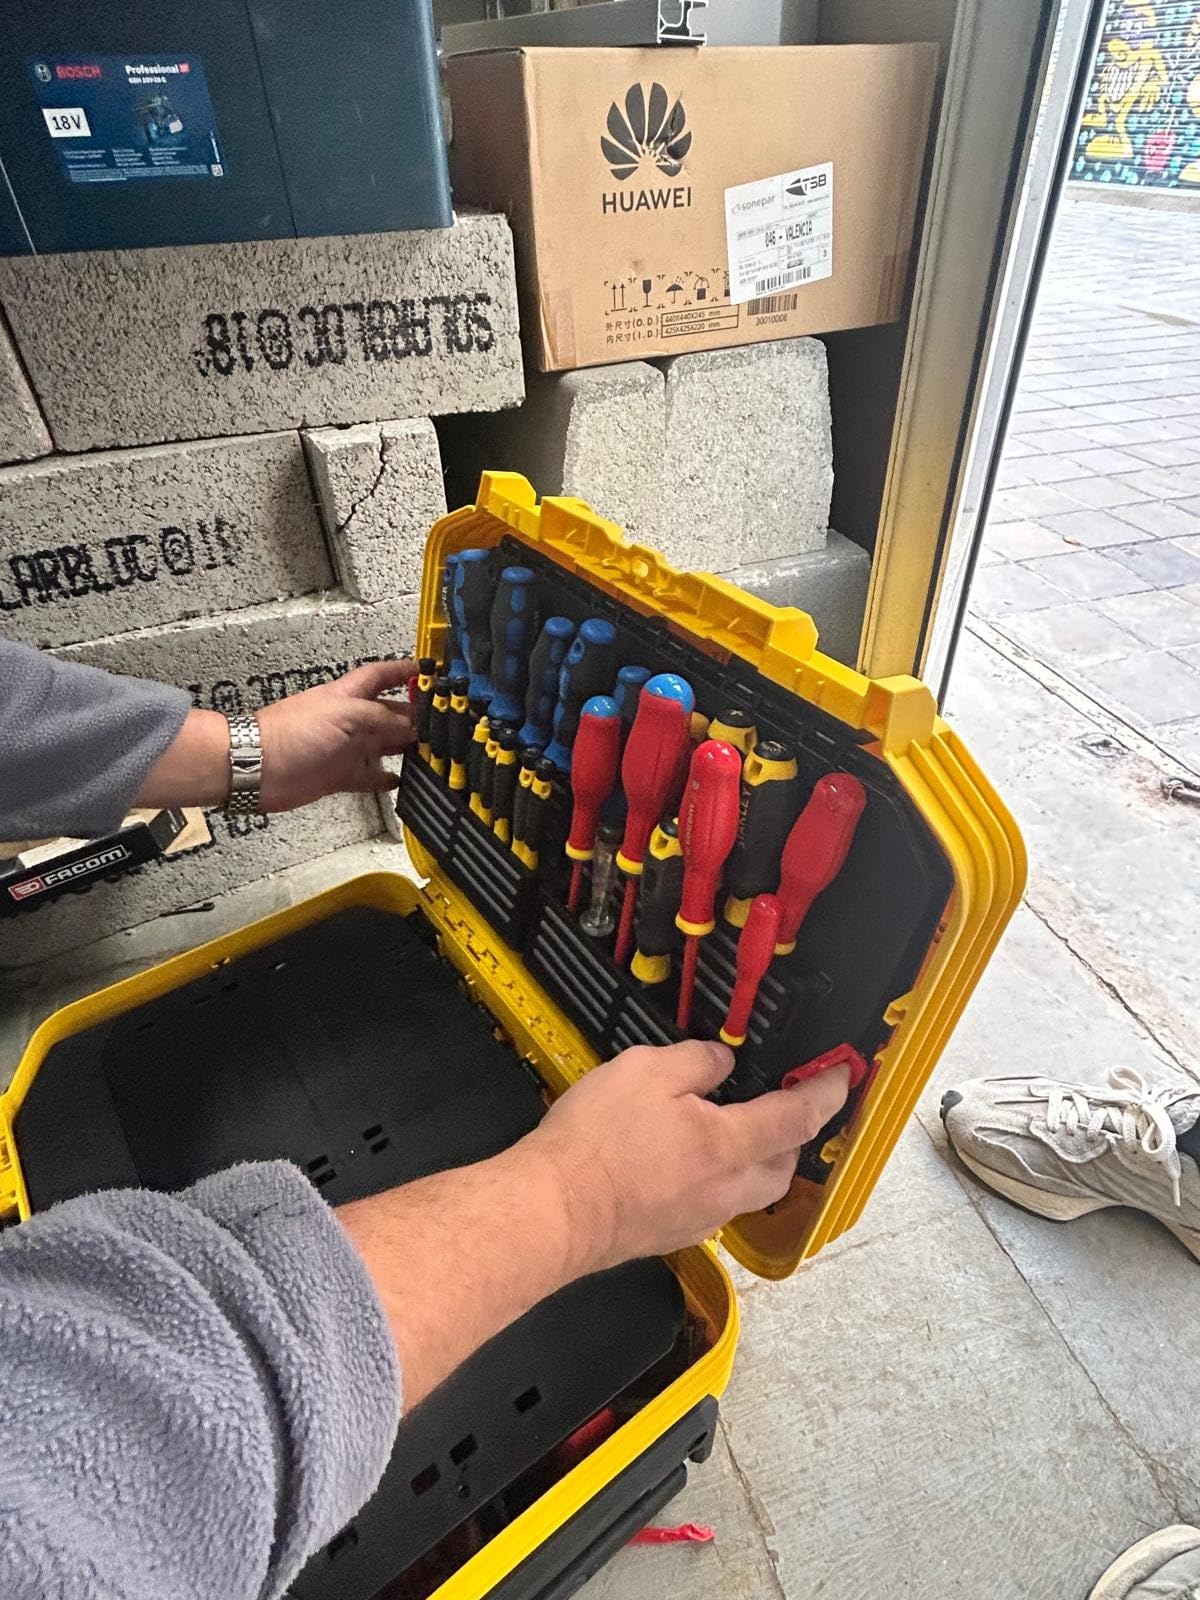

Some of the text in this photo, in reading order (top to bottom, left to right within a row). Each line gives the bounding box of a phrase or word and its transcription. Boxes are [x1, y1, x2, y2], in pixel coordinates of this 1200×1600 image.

[56, 65, 101, 79] BOSCH
[125, 64, 179, 75] Professional
[802, 173, 827, 193] TSB
[602, 186, 692, 214] HUAWEI
[741, 195, 775, 211] sonepar
[785, 220, 813, 241] VALENCIA
[44, 845, 123, 886] FACOM
